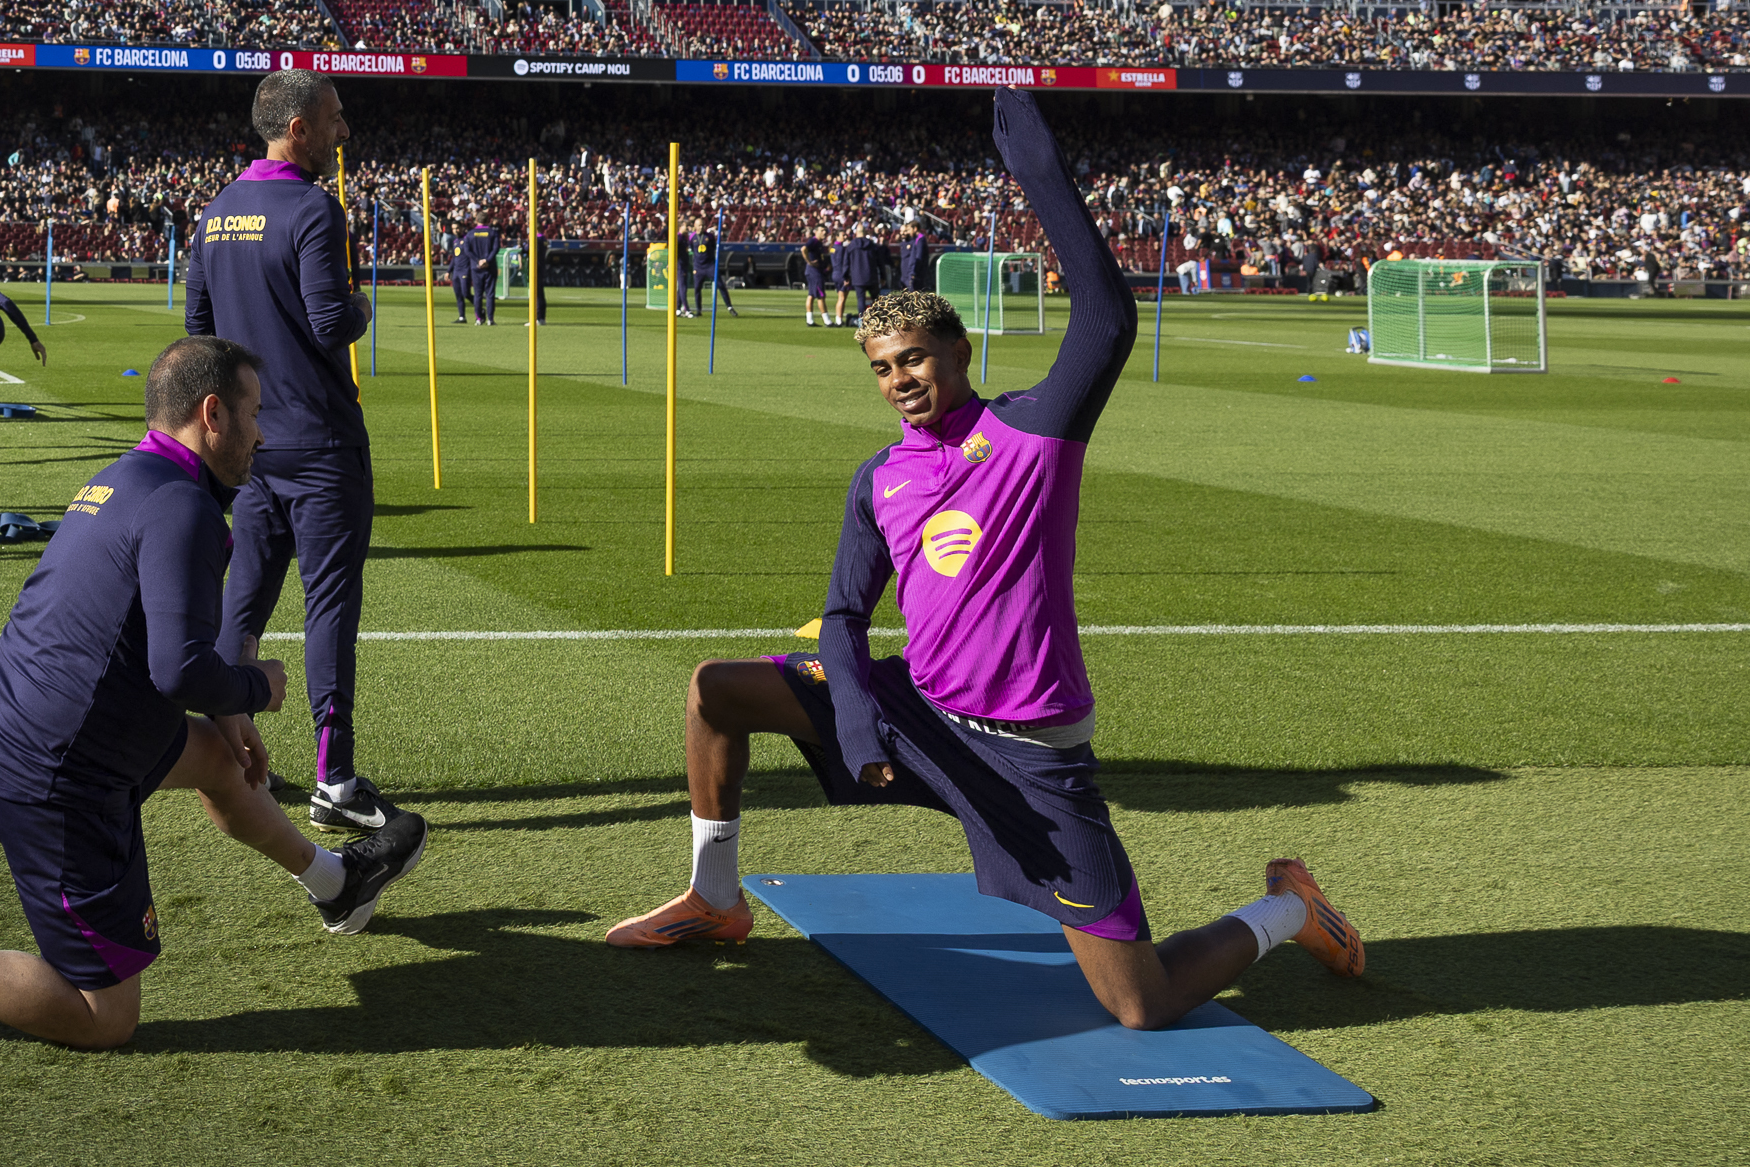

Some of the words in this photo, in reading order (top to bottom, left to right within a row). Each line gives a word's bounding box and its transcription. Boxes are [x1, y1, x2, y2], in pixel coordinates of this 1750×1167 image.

[96, 49, 112, 65] FC
[114, 50, 188, 67] BARCELONA
[213, 51, 226, 69] 0
[235, 52, 271, 69] 05:06
[280, 52, 293, 70] 0
[313, 53, 329, 71] FC
[331, 54, 405, 73] BARCELONA
[530, 62, 573, 74] SPOTIFY
[575, 62, 606, 74] CAMP
[607, 63, 630, 75] NOU
[734, 63, 749, 80] FC
[752, 64, 824, 81] BARCELONA
[847, 64, 860, 82] 0
[869, 65, 903, 83] 05:06
[912, 66, 925, 84] 0
[944, 67, 960, 84] FC
[962, 68, 1034, 85] BARCELONA
[1121, 73, 1165, 83] ESTRELLA
[224, 215, 266, 231] CONGO
[83, 485, 114, 505] CONGO
[1119, 1076, 1231, 1086] tecnosport.es
